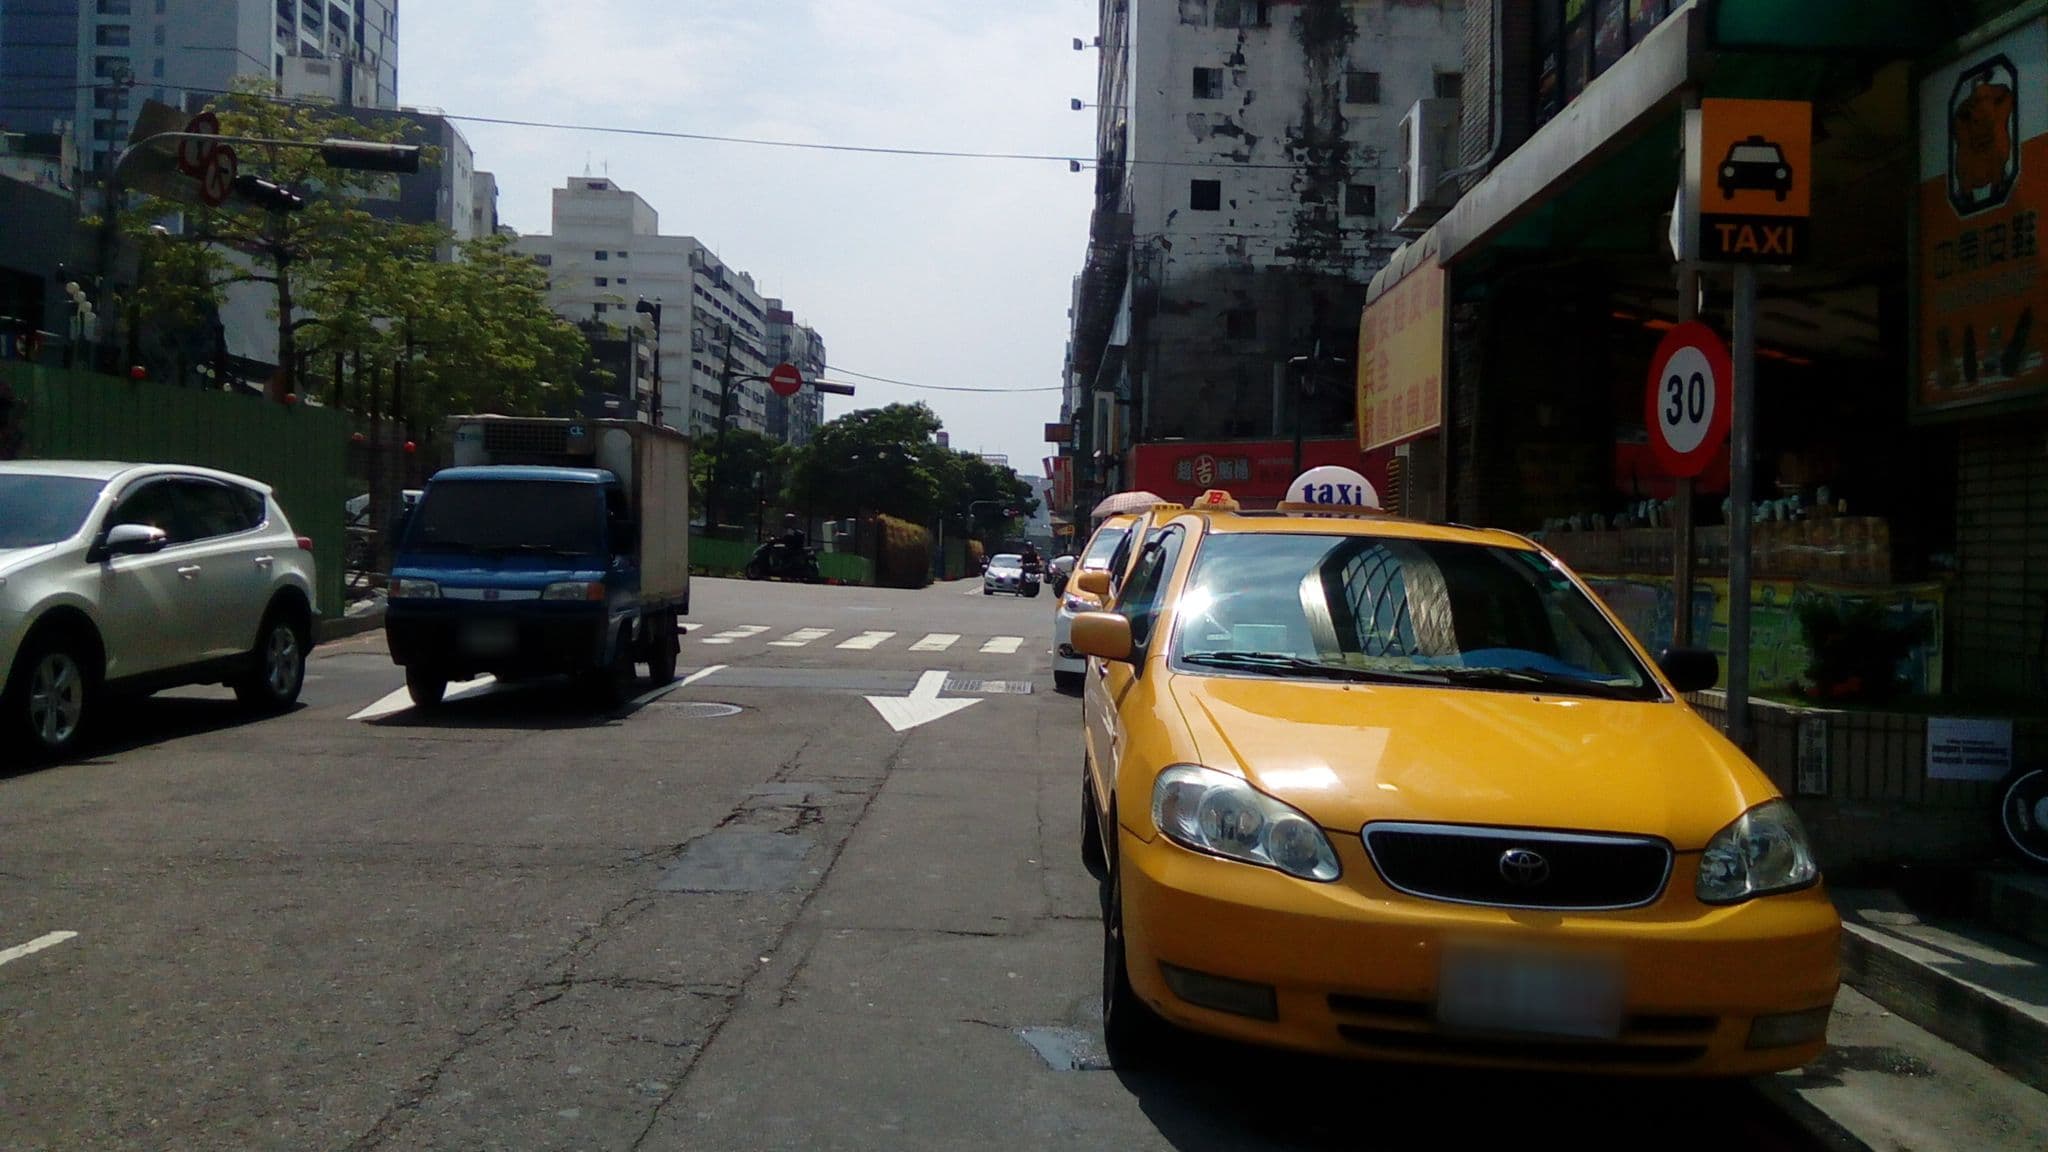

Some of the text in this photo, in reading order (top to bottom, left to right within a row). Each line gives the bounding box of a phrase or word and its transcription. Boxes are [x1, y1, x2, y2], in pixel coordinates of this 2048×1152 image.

[1714, 222, 1795, 256] TAXI
[1665, 371, 1706, 426] 30
[1302, 482, 1361, 505] taxi
